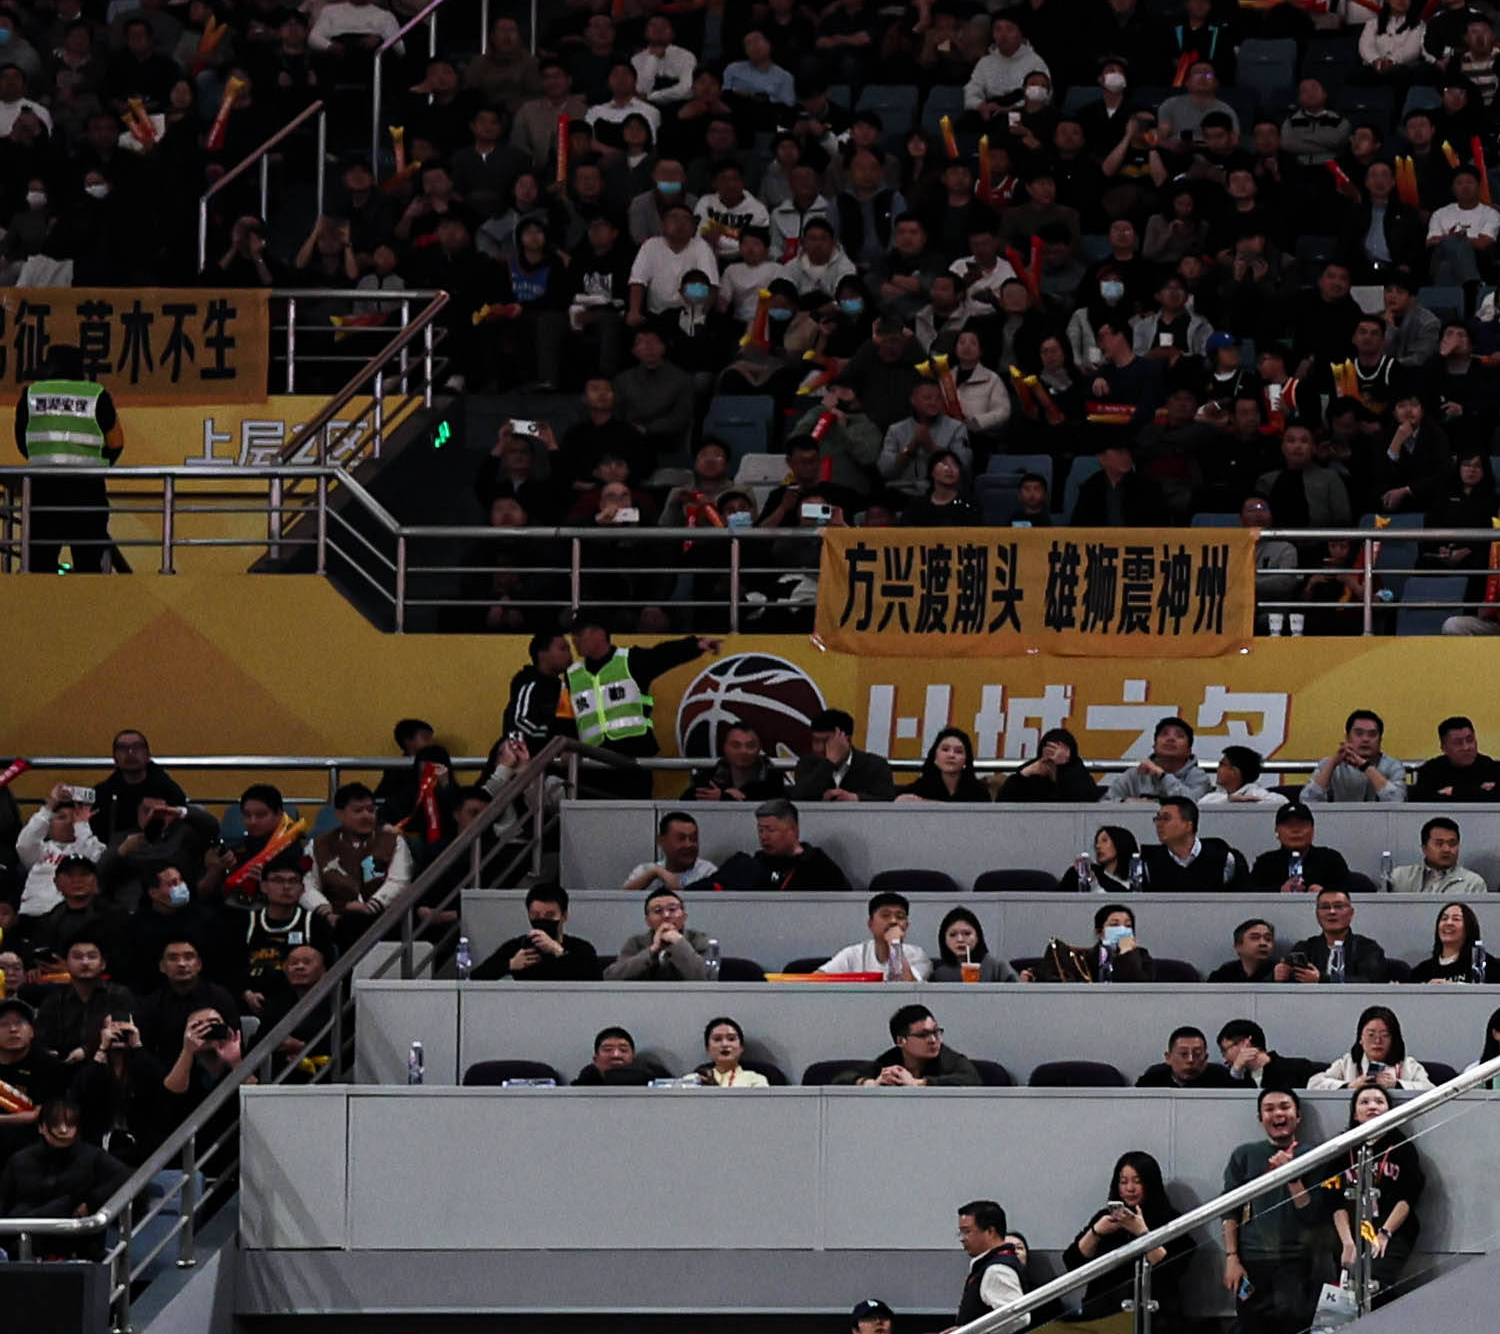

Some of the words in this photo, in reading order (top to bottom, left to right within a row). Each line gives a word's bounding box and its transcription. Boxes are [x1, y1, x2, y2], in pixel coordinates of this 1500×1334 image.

[0, 299, 50, 384] 征
[76, 299, 237, 384] 草木不生
[840, 542, 1024, 634] 方兴渡潮头
[1045, 541, 1230, 635] 雄狮震神州
